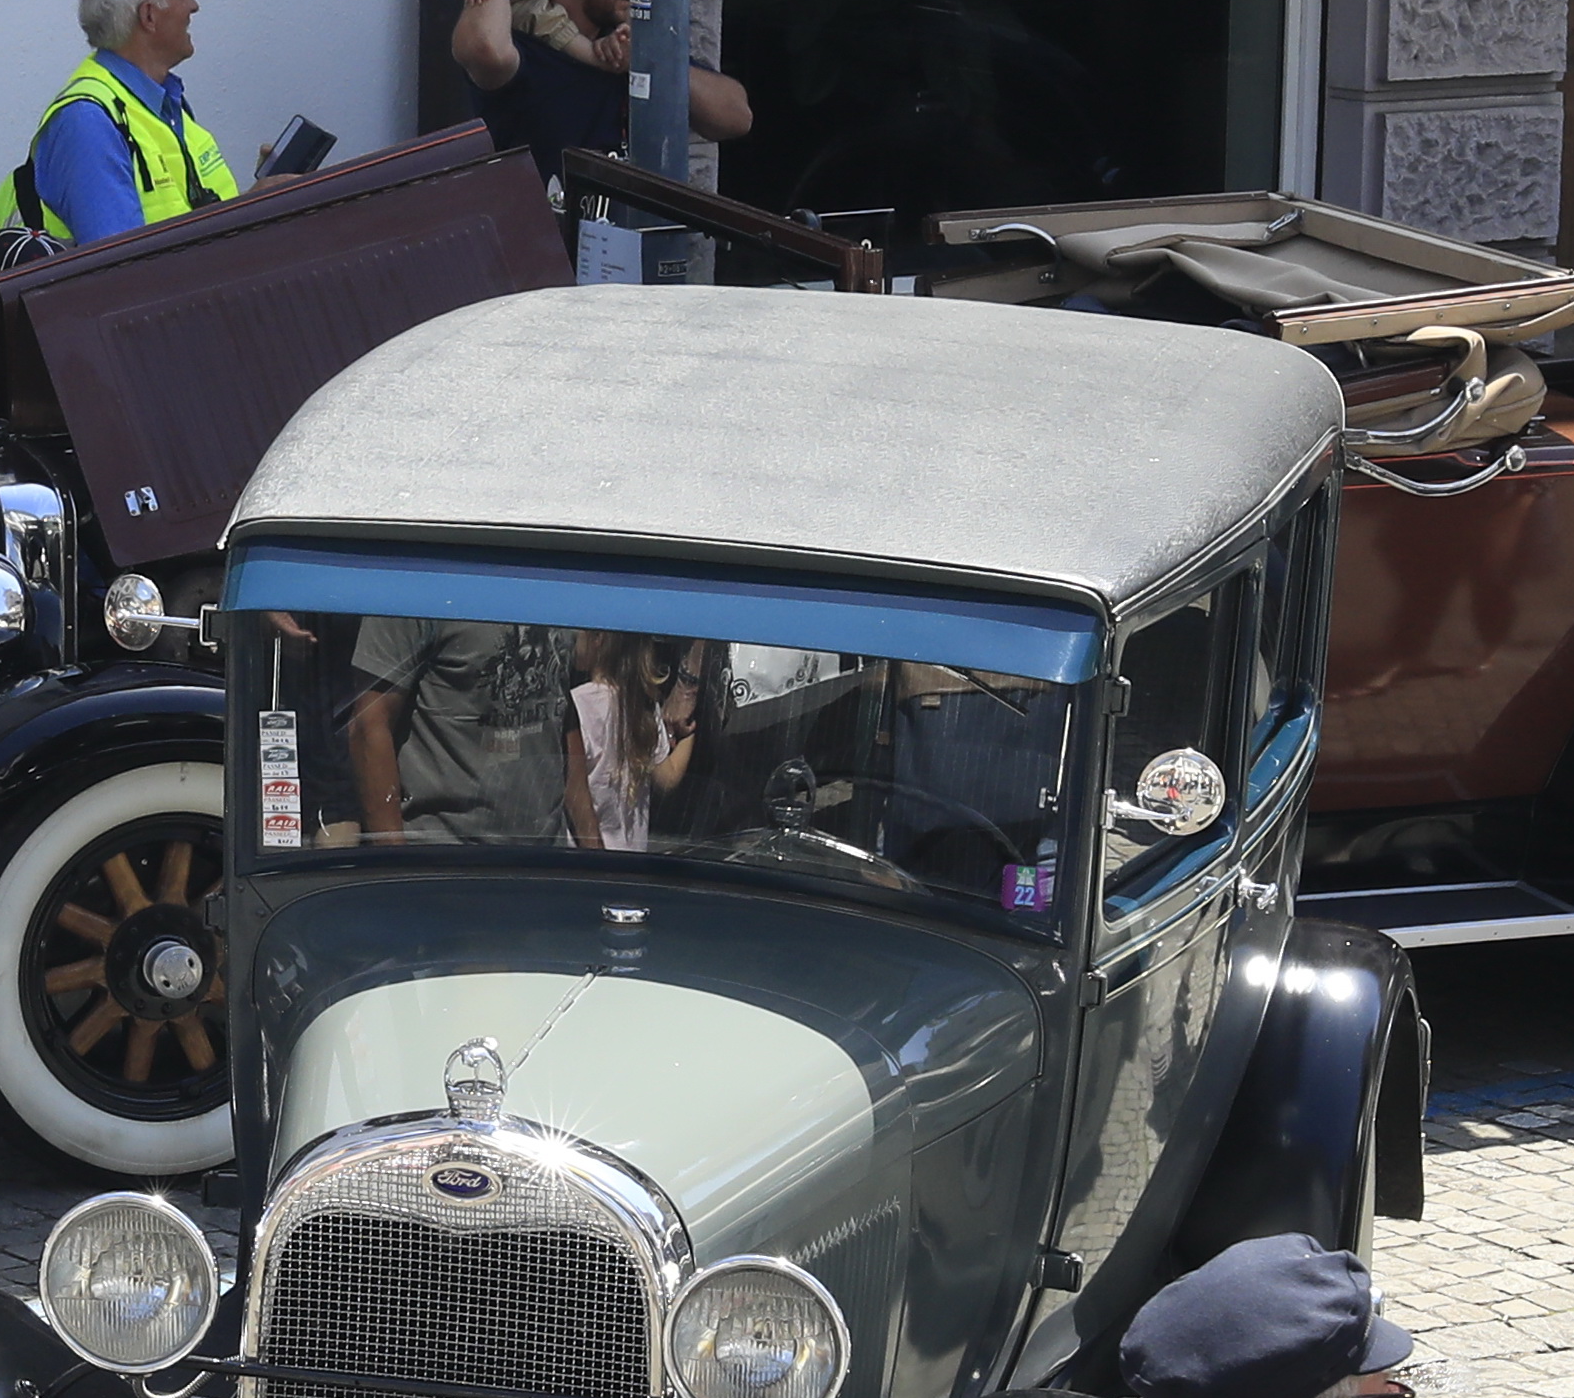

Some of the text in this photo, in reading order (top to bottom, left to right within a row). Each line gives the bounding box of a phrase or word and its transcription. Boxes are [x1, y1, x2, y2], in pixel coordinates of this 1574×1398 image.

[267, 785, 296, 793] RAID
[1014, 886, 1035, 906] 22
[437, 1169, 482, 1188] Ford
